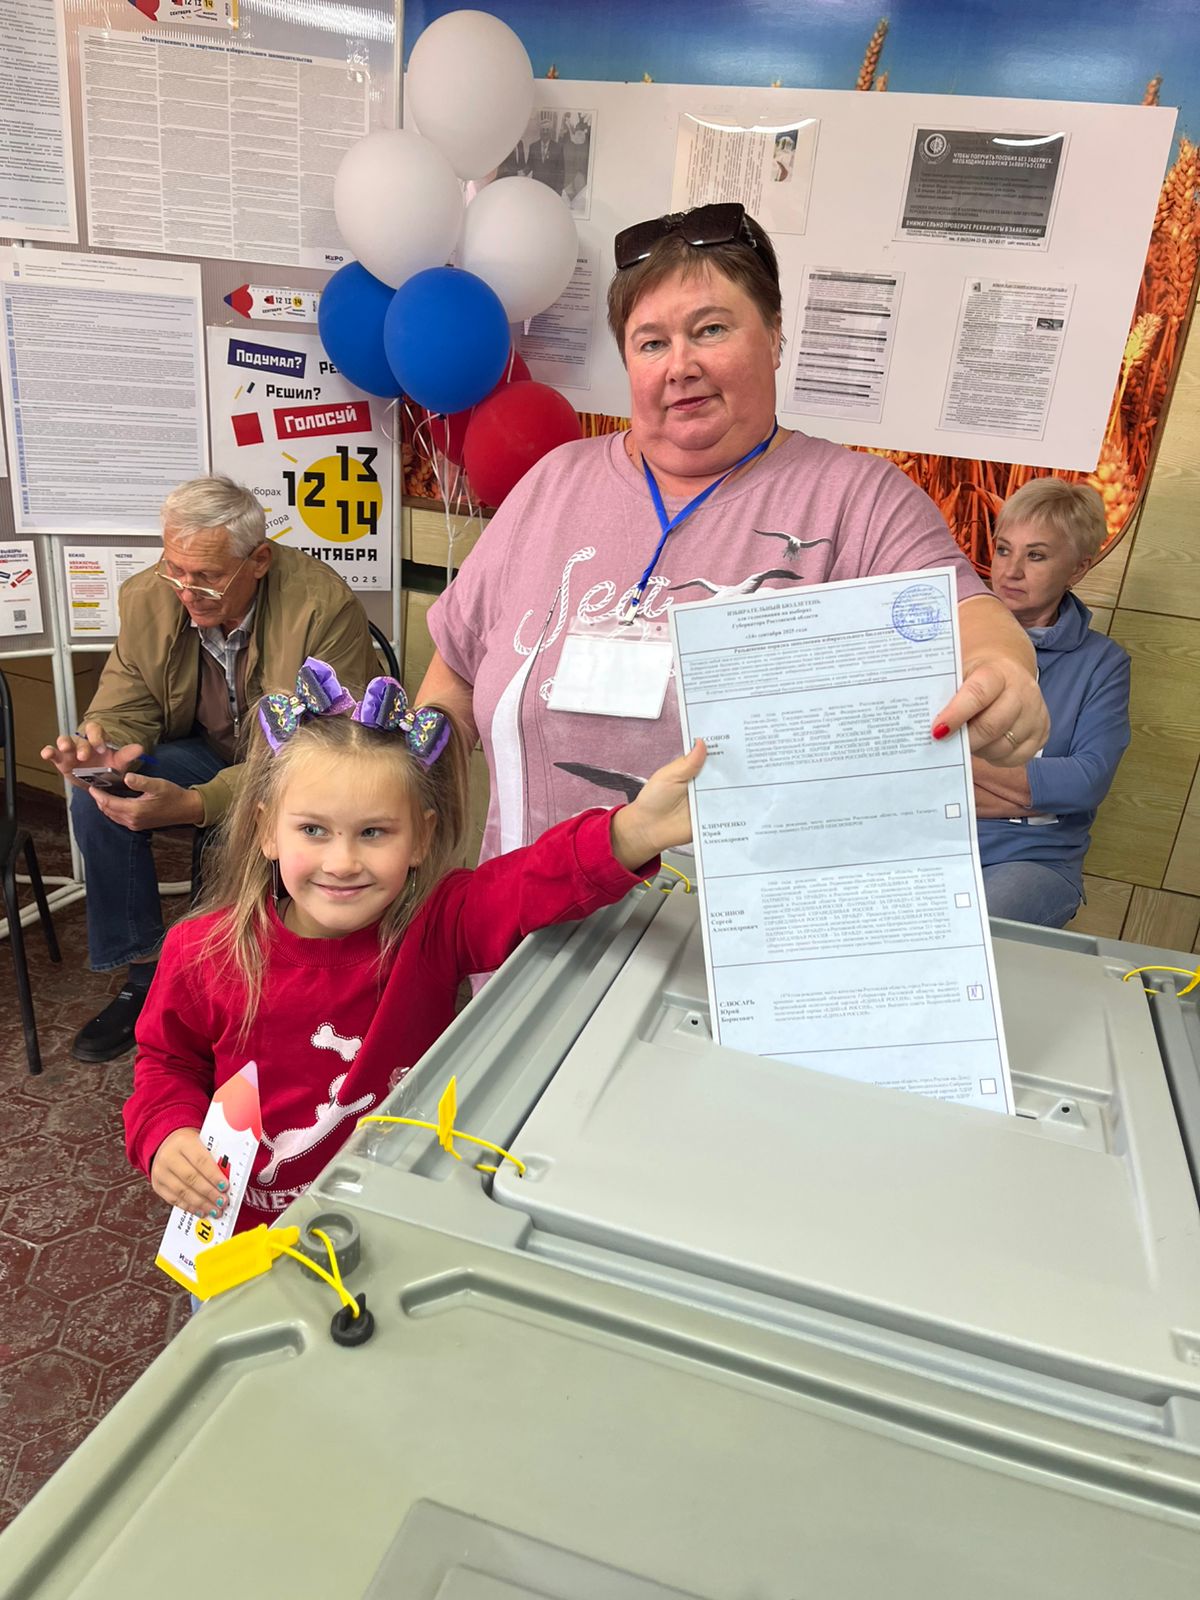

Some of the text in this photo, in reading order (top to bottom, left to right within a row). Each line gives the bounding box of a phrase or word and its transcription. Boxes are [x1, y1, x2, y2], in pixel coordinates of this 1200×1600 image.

[236, 348, 303, 369] Подумал?
[266, 384, 321, 400] Решил?
[284, 405, 357, 433] Голосуй
[336, 446, 378, 482] 13
[336, 500, 378, 535] 14
[702, 820, 746, 830] КЛИМЧЕНКО
[703, 830, 721, 838] Юрий
[710, 909, 745, 918] КОСИНОВ
[711, 918, 732, 926] Сергей
[720, 999, 755, 1008] СЛЮСАРЬ
[720, 1008, 739, 1016] Юрий
[721, 1015, 755, 1024] Борисович
[198, 1222, 211, 1240] 14
